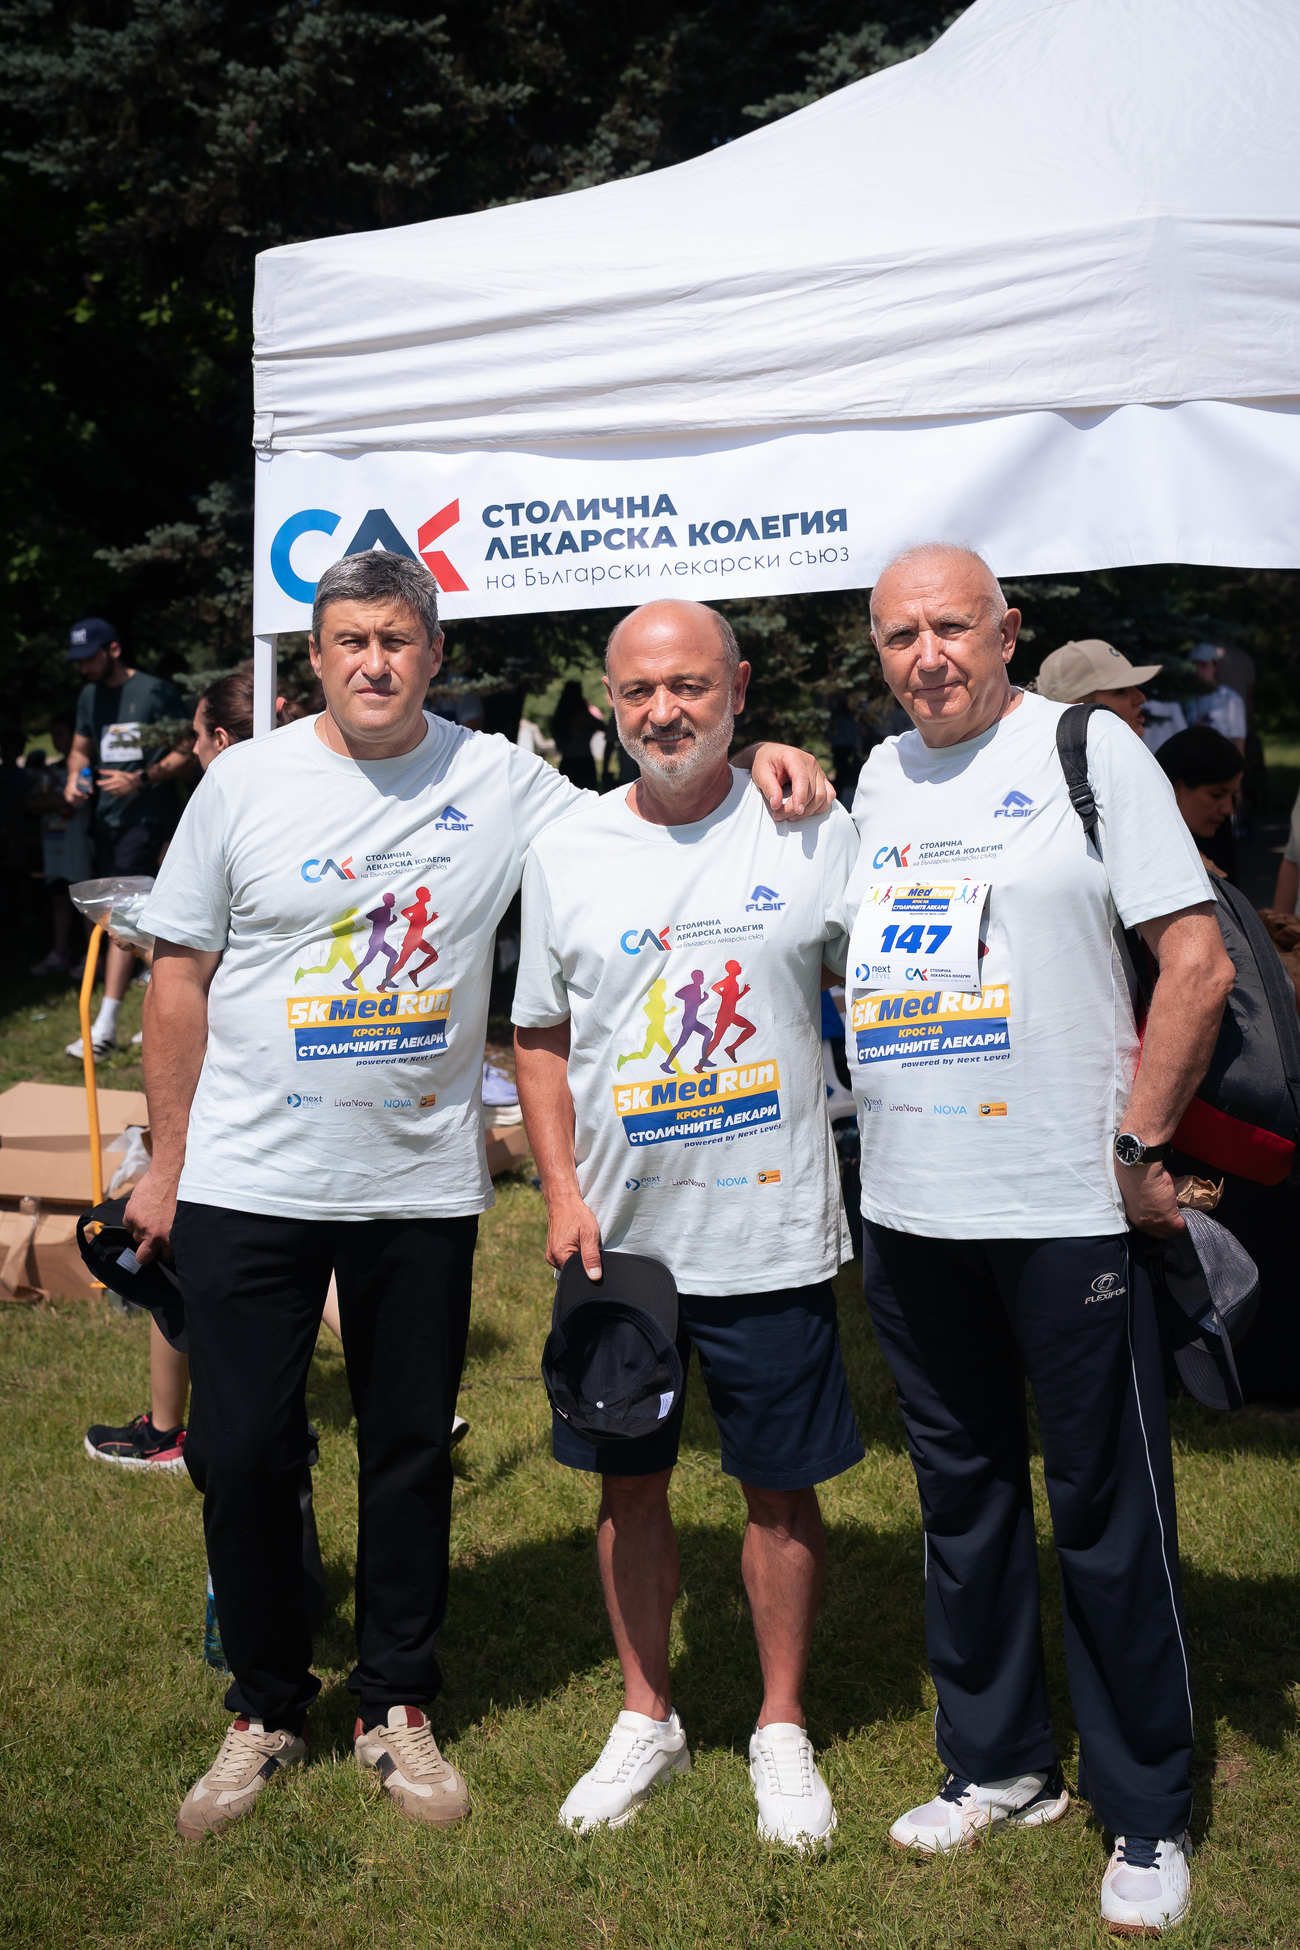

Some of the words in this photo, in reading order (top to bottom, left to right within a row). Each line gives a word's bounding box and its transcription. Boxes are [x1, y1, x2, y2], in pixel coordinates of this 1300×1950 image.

[482, 493, 678, 528] СТОЛИЧНА
[484, 525, 675, 561] ЛЕКАРСКА
[688, 508, 848, 547] КОЛЕГИЯ
[486, 572, 516, 589] на
[525, 561, 650, 588] Български
[659, 552, 781, 580] лекарски
[790, 546, 850, 567] съюз
[919, 849, 960, 859] ЛЕКАРСКА
[963, 844, 1003, 854] КОЛЕГИЯ
[920, 840, 963, 850] СТОЛИЧНА
[365, 851, 412, 862] СТОЛИЧНА
[366, 860, 413, 872] ЛЕКАРСКА
[415, 856, 451, 866] КОЛЕГИЯ
[676, 919, 721, 932] СТОЛИЧНА
[676, 928, 722, 942] ЛЕКАРСКА
[723, 923, 764, 934] КОЛЕГИЯ
[880, 925, 953, 954] 147
[872, 964, 891, 973] next
[290, 992, 450, 1025] 5kMedRun
[853, 988, 1005, 1028] 5kMedRun
[352, 1027, 384, 1037] КРОС
[386, 1026, 401, 1035] НА
[898, 1026, 926, 1038] КРОС
[928, 1025, 943, 1035] НА
[298, 1039, 398, 1057] СТОЛИЧНИТЕ
[399, 1032, 444, 1049] ЛЕКАРИ
[859, 1038, 940, 1061] СТОЛИЧНИТЕ
[941, 1032, 1006, 1050] ЛЕКАРИ
[356, 1058, 396, 1066] powered
[901, 1058, 940, 1069] powered
[942, 1057, 954, 1066] by
[957, 1056, 981, 1064] Next
[984, 1053, 1011, 1062] Level
[617, 1063, 774, 1112] 5kMedRun
[334, 1099, 373, 1107] LivaNova
[383, 1099, 412, 1108] NOVA
[889, 1103, 923, 1113] LivaNova
[933, 1105, 968, 1115] NOVA
[676, 1108, 706, 1121] КРОС
[708, 1105, 725, 1116] НА
[629, 1118, 722, 1144] СТОЛИЧНИТЕ
[724, 1104, 778, 1128] ЛЕКАРИ
[684, 1136, 723, 1148] powered
[725, 1134, 735, 1142] by
[738, 1130, 758, 1139] Next
[760, 1123, 782, 1134] Level
[641, 1175, 661, 1183] next
[672, 1178, 706, 1188] LivaNova
[717, 1176, 748, 1188] NOVA
